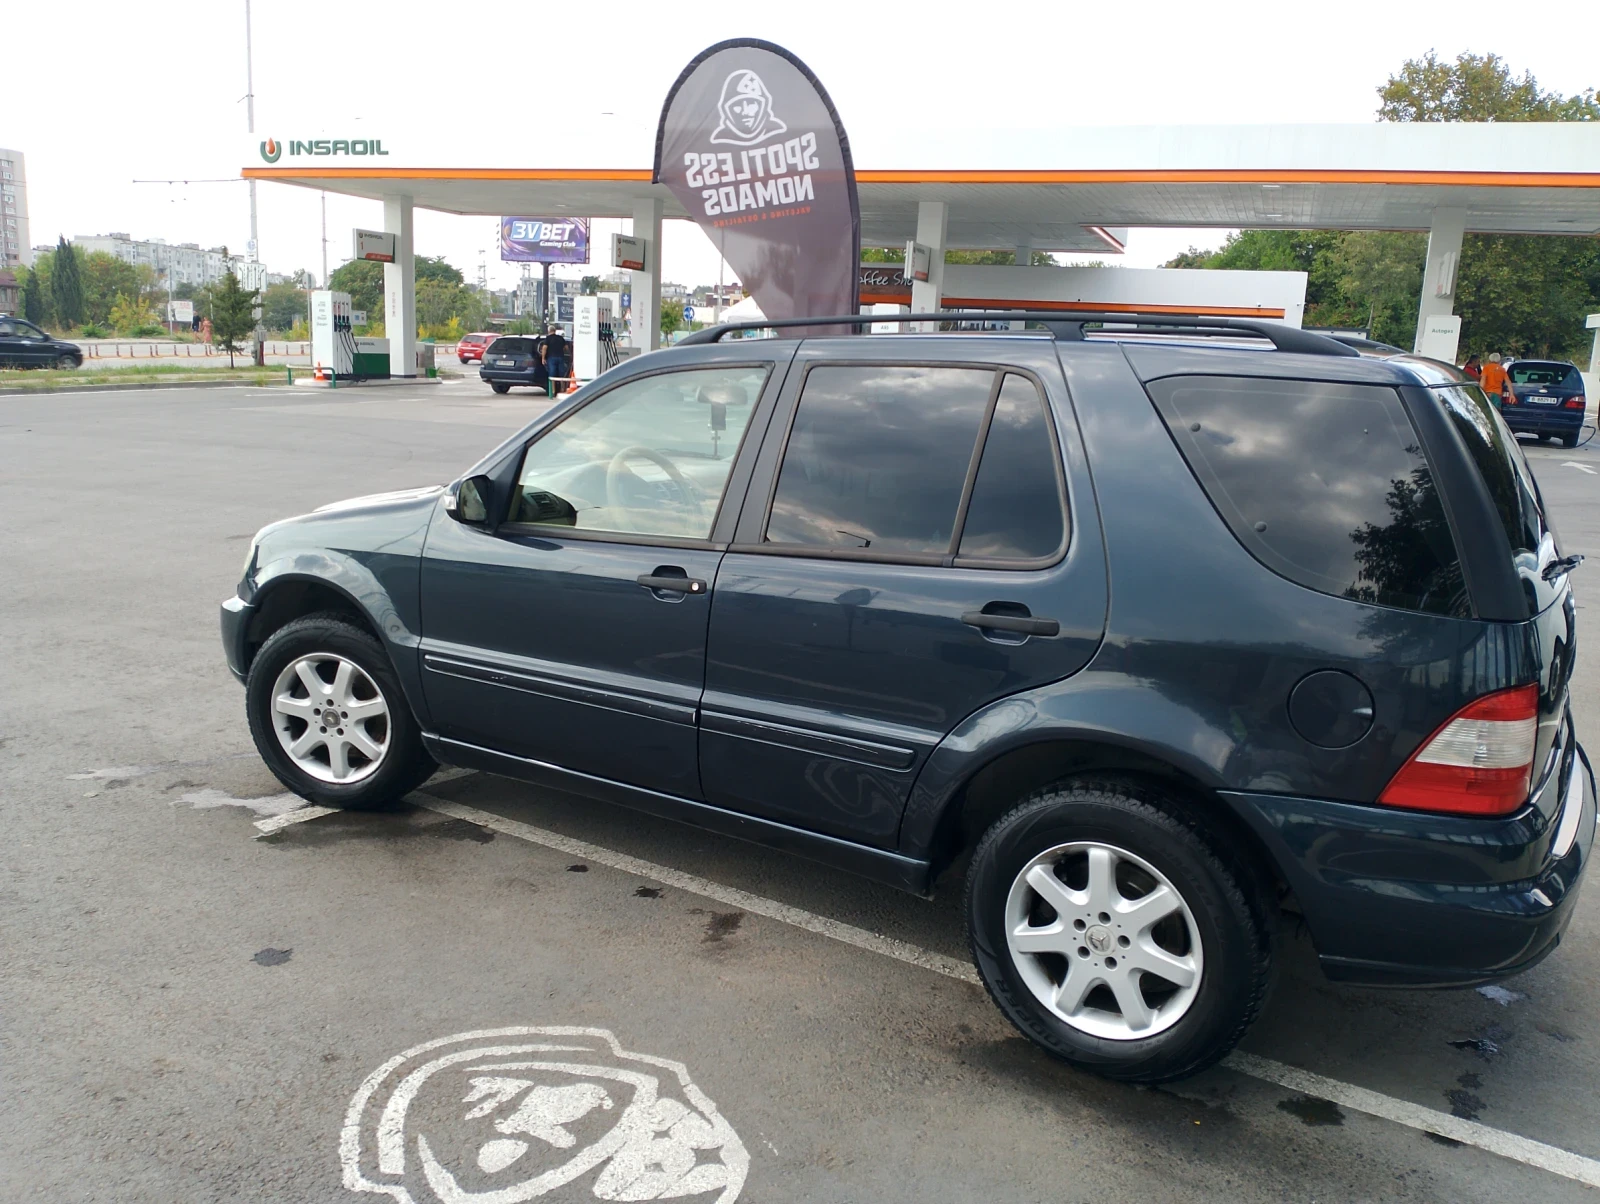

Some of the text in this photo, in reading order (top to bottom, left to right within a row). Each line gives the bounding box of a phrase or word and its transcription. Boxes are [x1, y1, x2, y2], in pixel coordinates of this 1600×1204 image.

[289, 140, 389, 155] INSAOIL
[512, 223, 575, 240] 3VBET
[860, 270, 889, 286] offee
